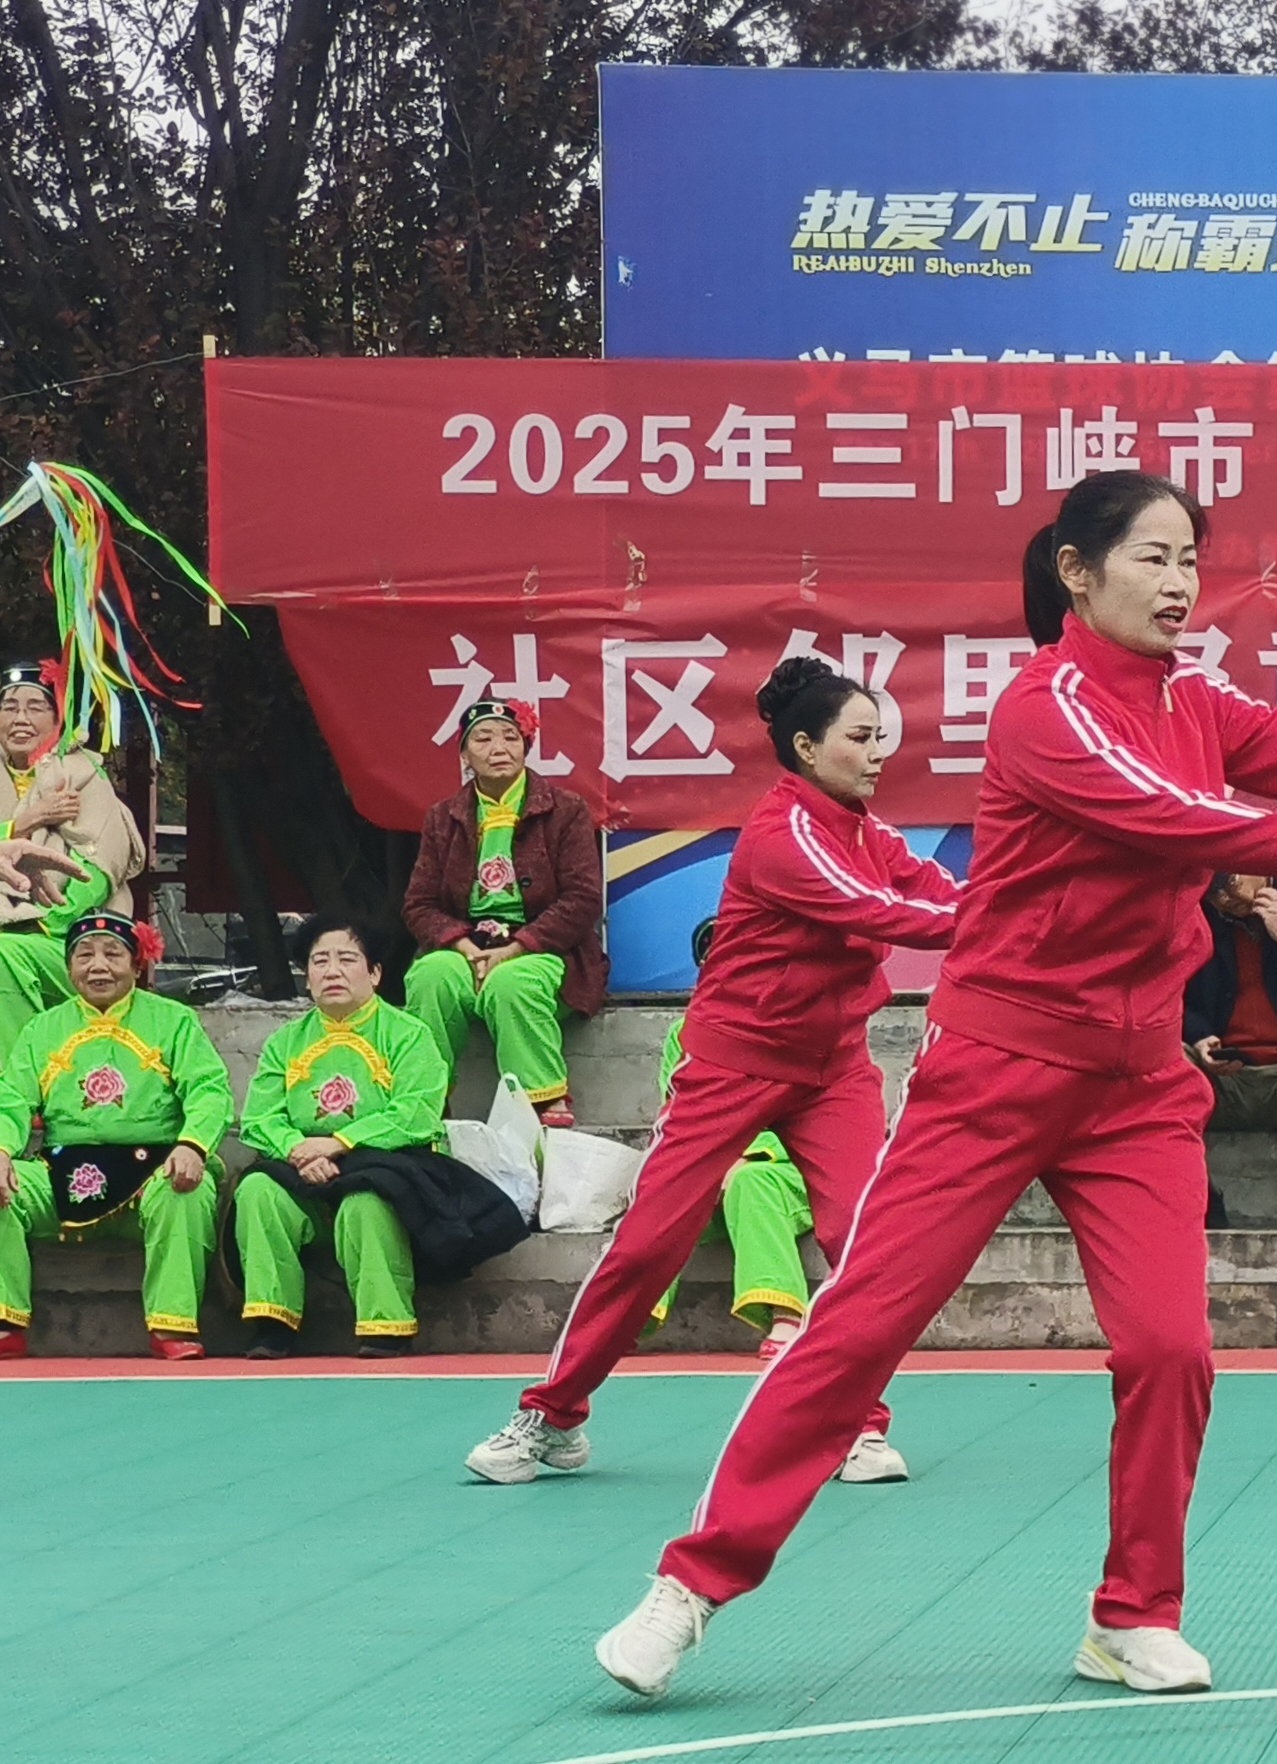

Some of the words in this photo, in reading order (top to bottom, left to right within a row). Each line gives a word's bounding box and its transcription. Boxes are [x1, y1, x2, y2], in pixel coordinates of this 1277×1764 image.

[789, 188, 1110, 252] 热爱不止
[924, 256, 1032, 277] Shenzhen
